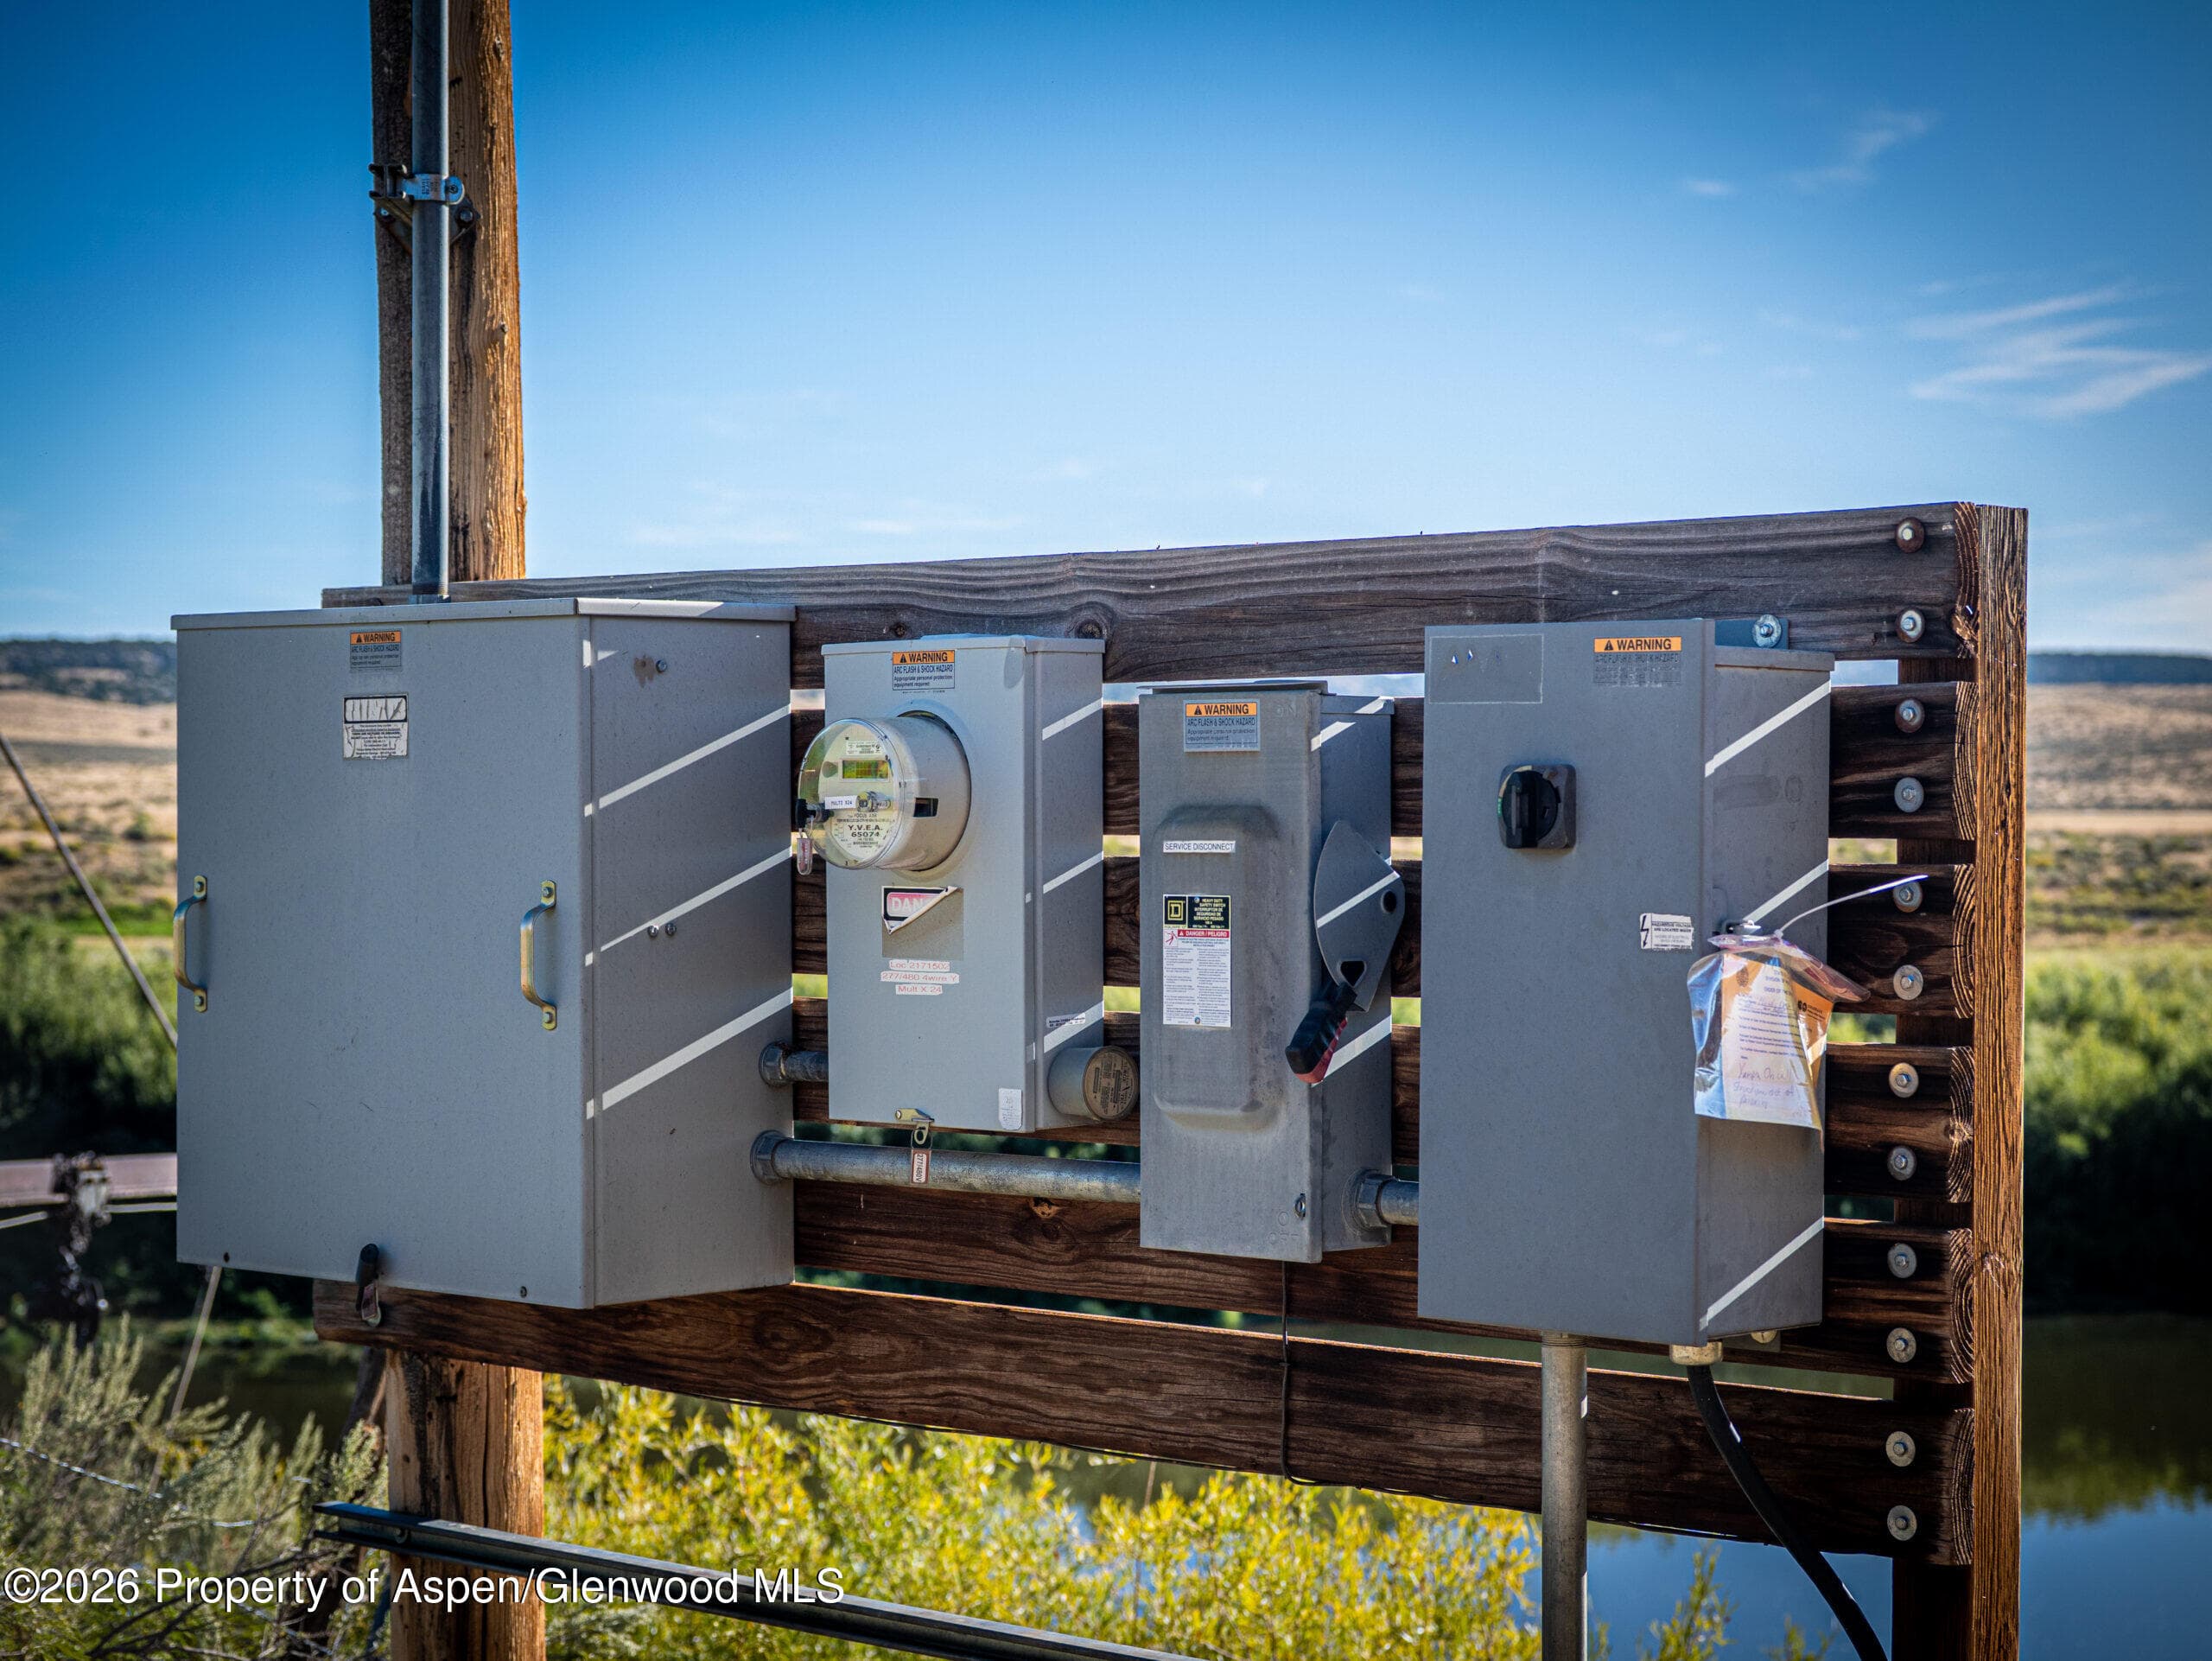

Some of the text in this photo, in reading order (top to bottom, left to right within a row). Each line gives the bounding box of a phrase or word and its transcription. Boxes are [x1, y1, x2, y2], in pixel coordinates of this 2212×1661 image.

[364, 633, 396, 642] WARNING
[1617, 638, 1672, 651] WARNING
[909, 652, 948, 663] WARNING
[921, 665, 935, 673] SHOCK
[936, 664, 953, 672] HAZARD
[1205, 703, 1249, 715] WARNING
[1187, 718, 1198, 727] ARC
[1198, 718, 1213, 727] FLASH
[1218, 717, 1235, 726] SHOCK
[1236, 717, 1255, 726] HAZARD
[1165, 843, 1234, 851] SERVICE DISCONNECT
[882, 971, 920, 981] 277/480
